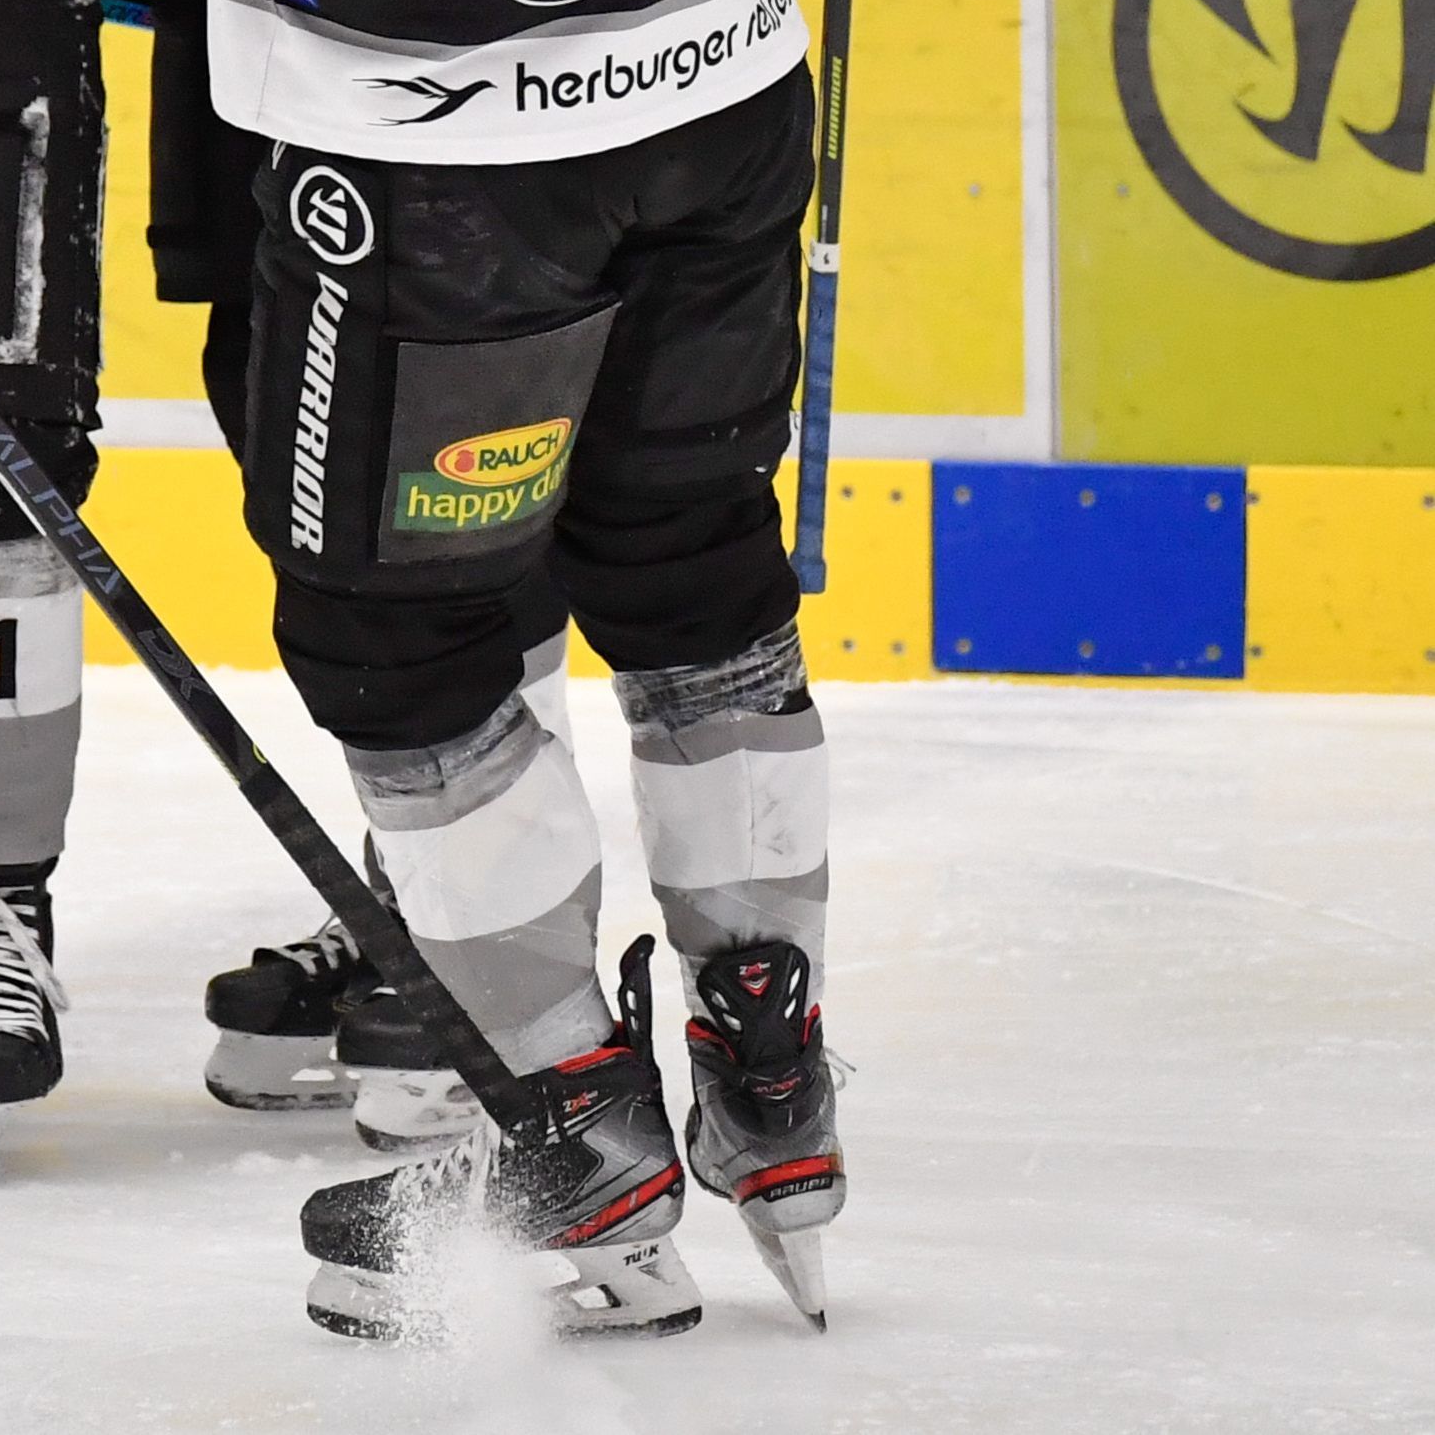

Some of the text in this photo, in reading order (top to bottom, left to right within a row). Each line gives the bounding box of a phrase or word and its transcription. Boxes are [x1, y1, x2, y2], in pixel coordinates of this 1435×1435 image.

[515, 22, 739, 112] herburger
[290, 270, 350, 555] WARRIOR
[477, 427, 561, 472] RAUCH
[407, 449, 570, 528] happy da
